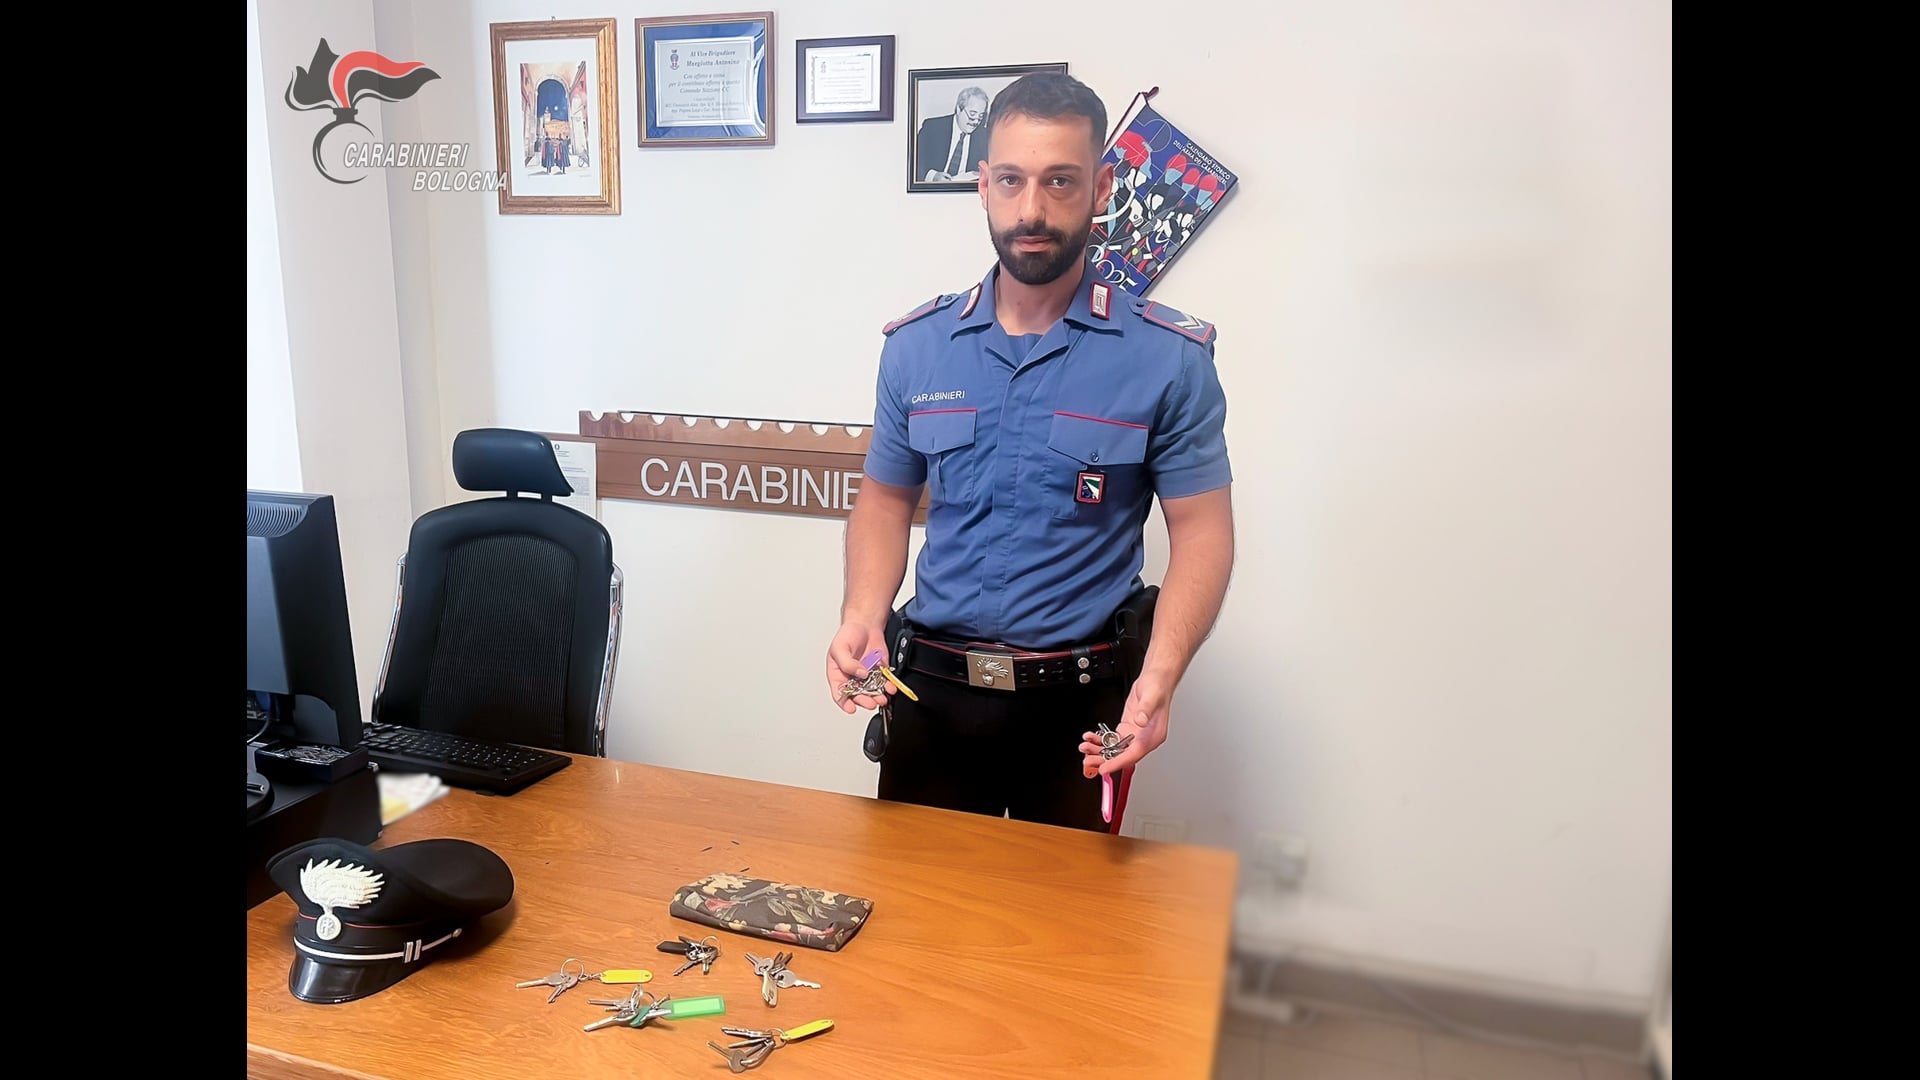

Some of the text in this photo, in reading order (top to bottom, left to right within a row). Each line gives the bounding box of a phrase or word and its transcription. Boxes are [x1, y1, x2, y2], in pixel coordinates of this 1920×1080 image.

[1186, 142, 1231, 180] CALENDARIO STORICO
[911, 390, 966, 404] CARABINIERI
[640, 457, 865, 511] CARABINIE
